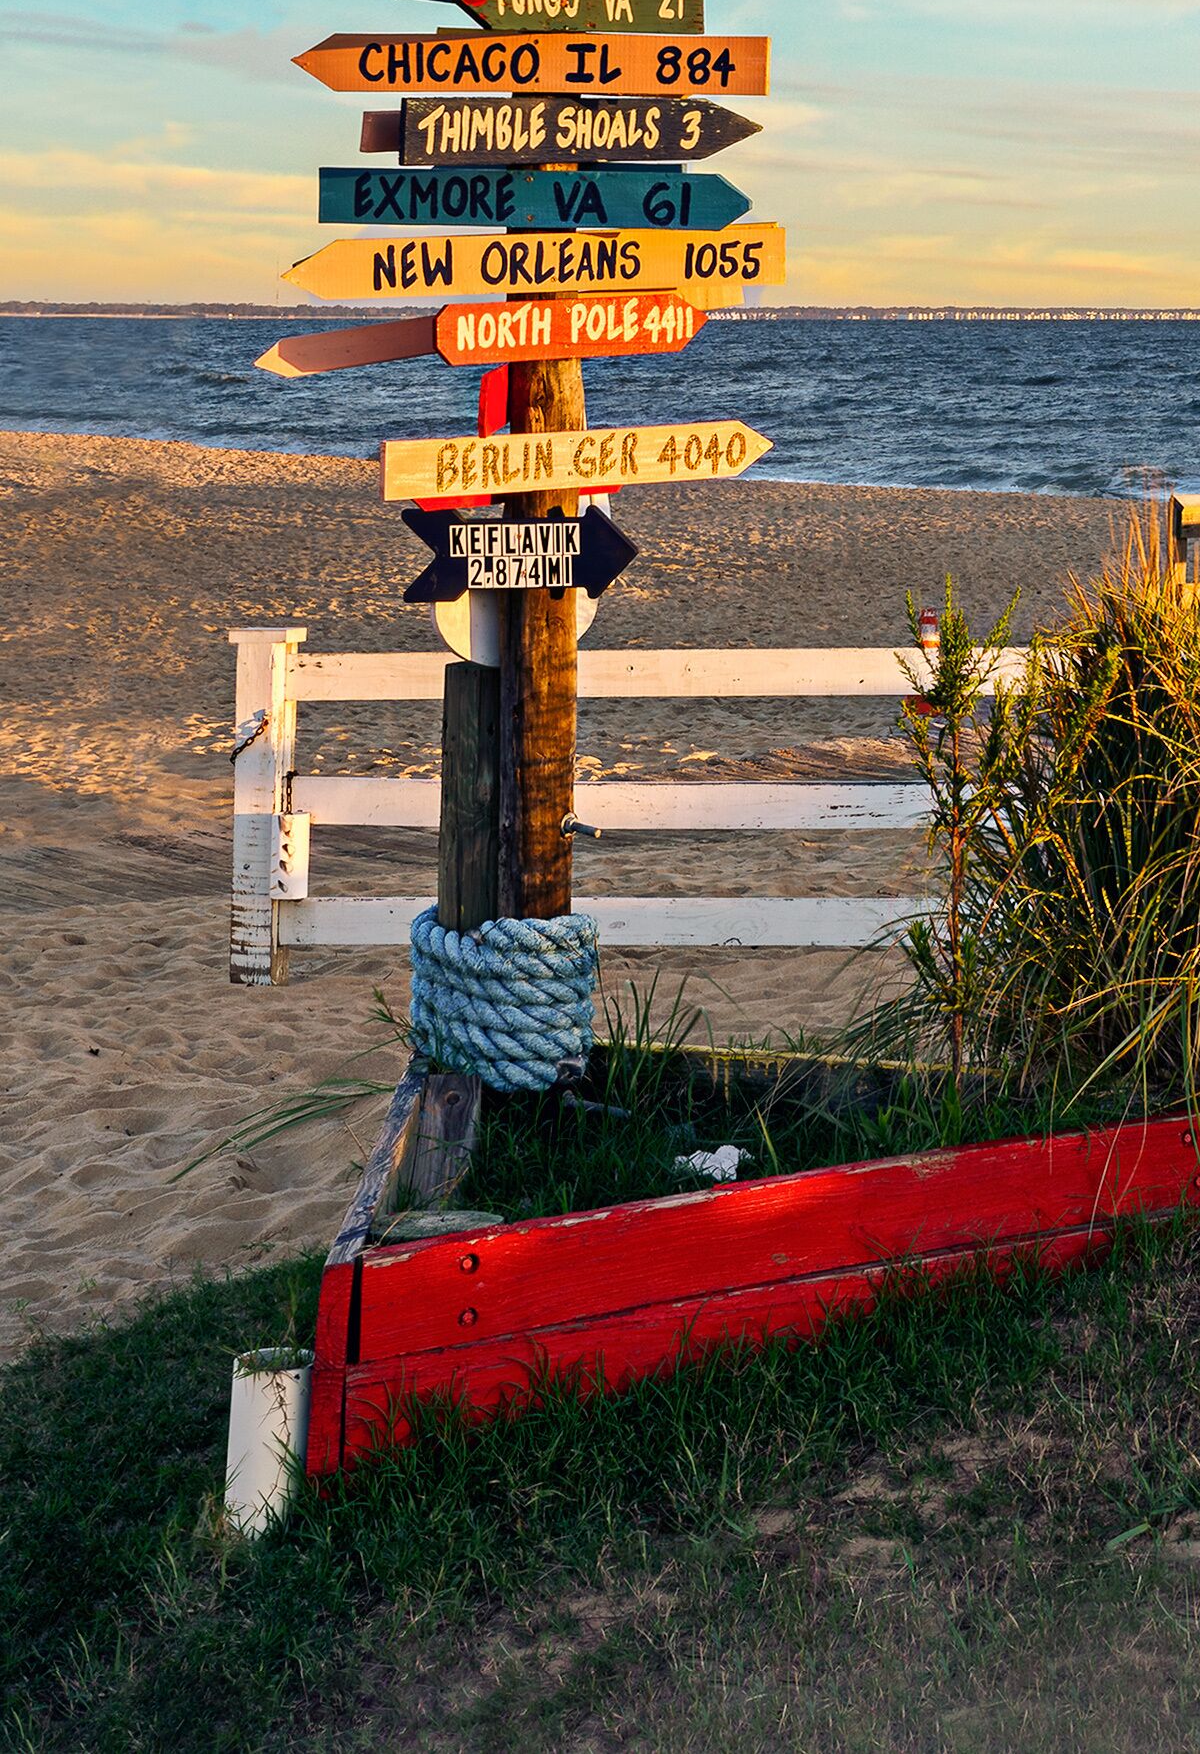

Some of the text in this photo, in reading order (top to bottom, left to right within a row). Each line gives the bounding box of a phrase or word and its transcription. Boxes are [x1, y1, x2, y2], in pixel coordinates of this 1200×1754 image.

[358, 42, 736, 88] CHICAGO IL 884
[417, 103, 702, 155] THIMBLE SHOALS 3
[353, 171, 691, 227] EXMORE VA 61
[373, 239, 762, 291] NEW ORLEANS 1055
[457, 296, 694, 352] NORTH POLE 4411
[436, 431, 746, 494] BERLIN GER 4040
[451, 525, 578, 555] KEFLAVIK
[470, 556, 570, 586] 2,874 MI
